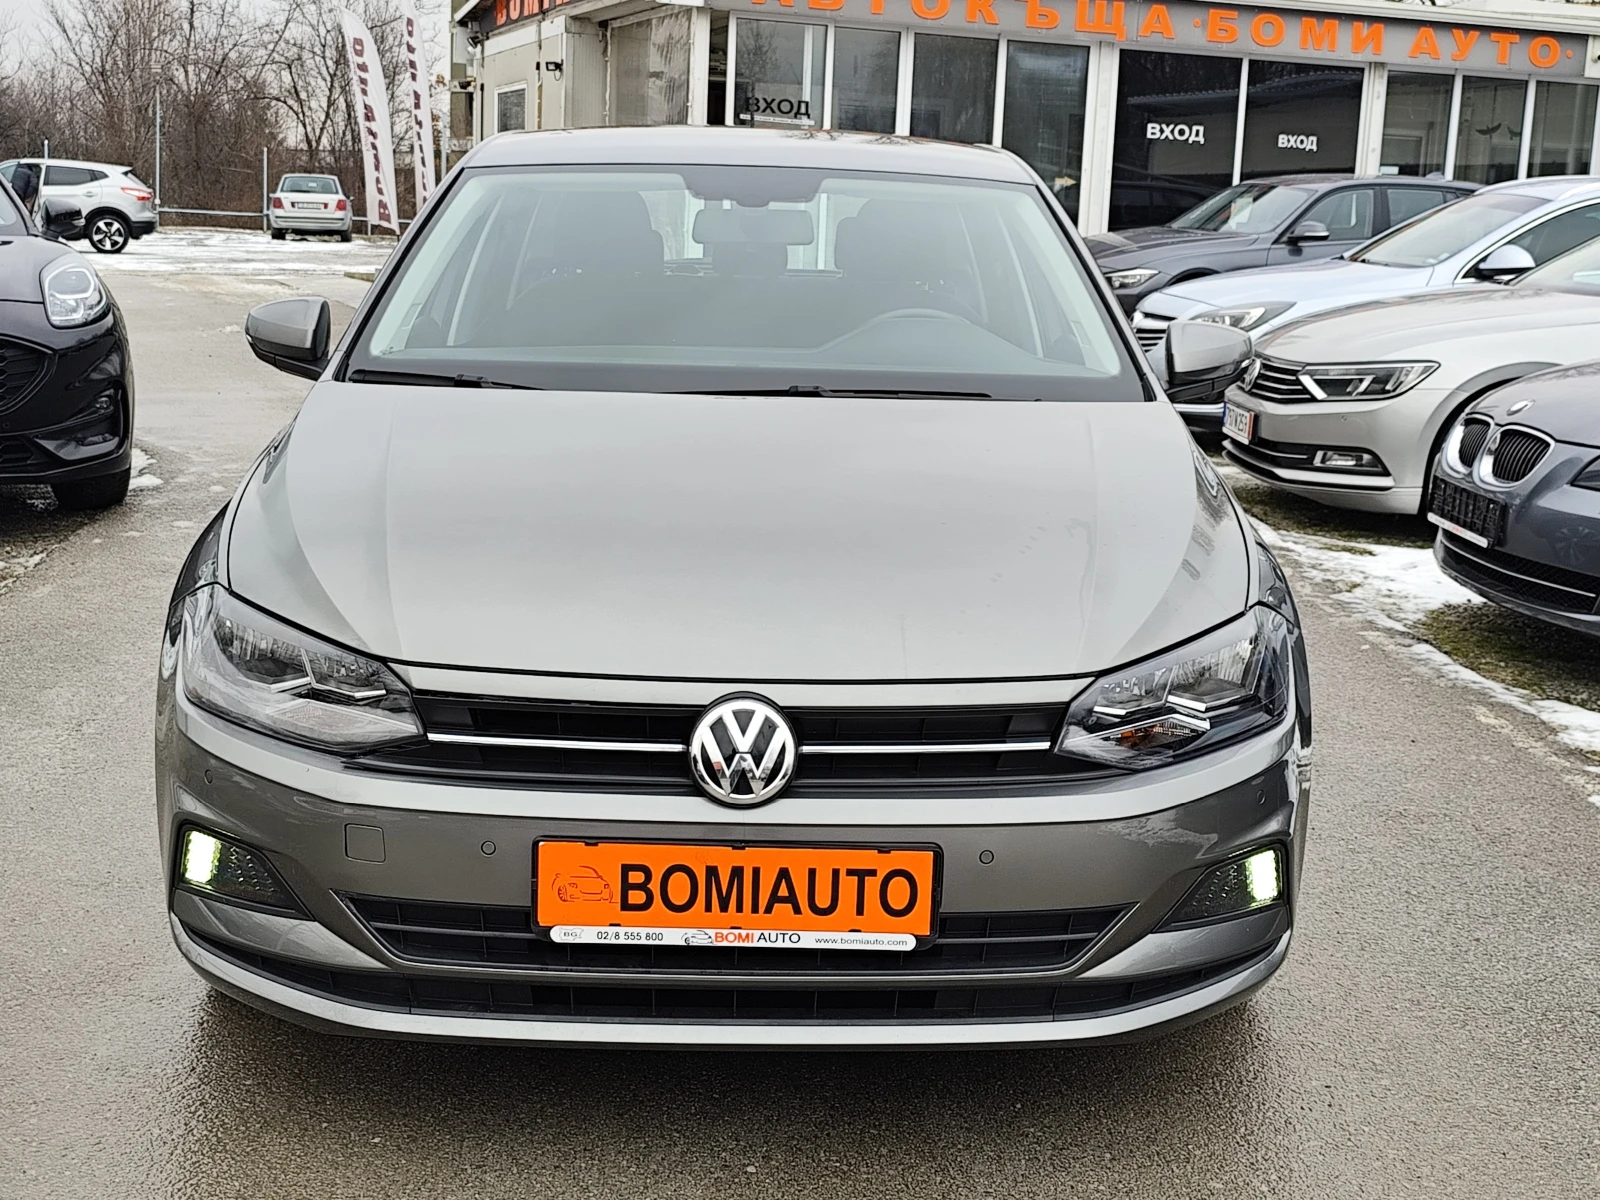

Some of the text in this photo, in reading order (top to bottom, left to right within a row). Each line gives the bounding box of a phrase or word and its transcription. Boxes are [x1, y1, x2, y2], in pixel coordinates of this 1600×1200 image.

[1206, 8, 1385, 55] БОМИ
[1408, 27, 1561, 68] АУТО
[745, 97, 811, 119] ВХОД
[1146, 123, 1205, 144] ВХОД
[1277, 134, 1318, 152] ВХОД
[619, 862, 919, 918] BOMIAUTO
[596, 931, 664, 942] 02/8 555 800
[714, 931, 801, 944] BOMI AUTO
[814, 937, 908, 947] www.bomiauto.com
